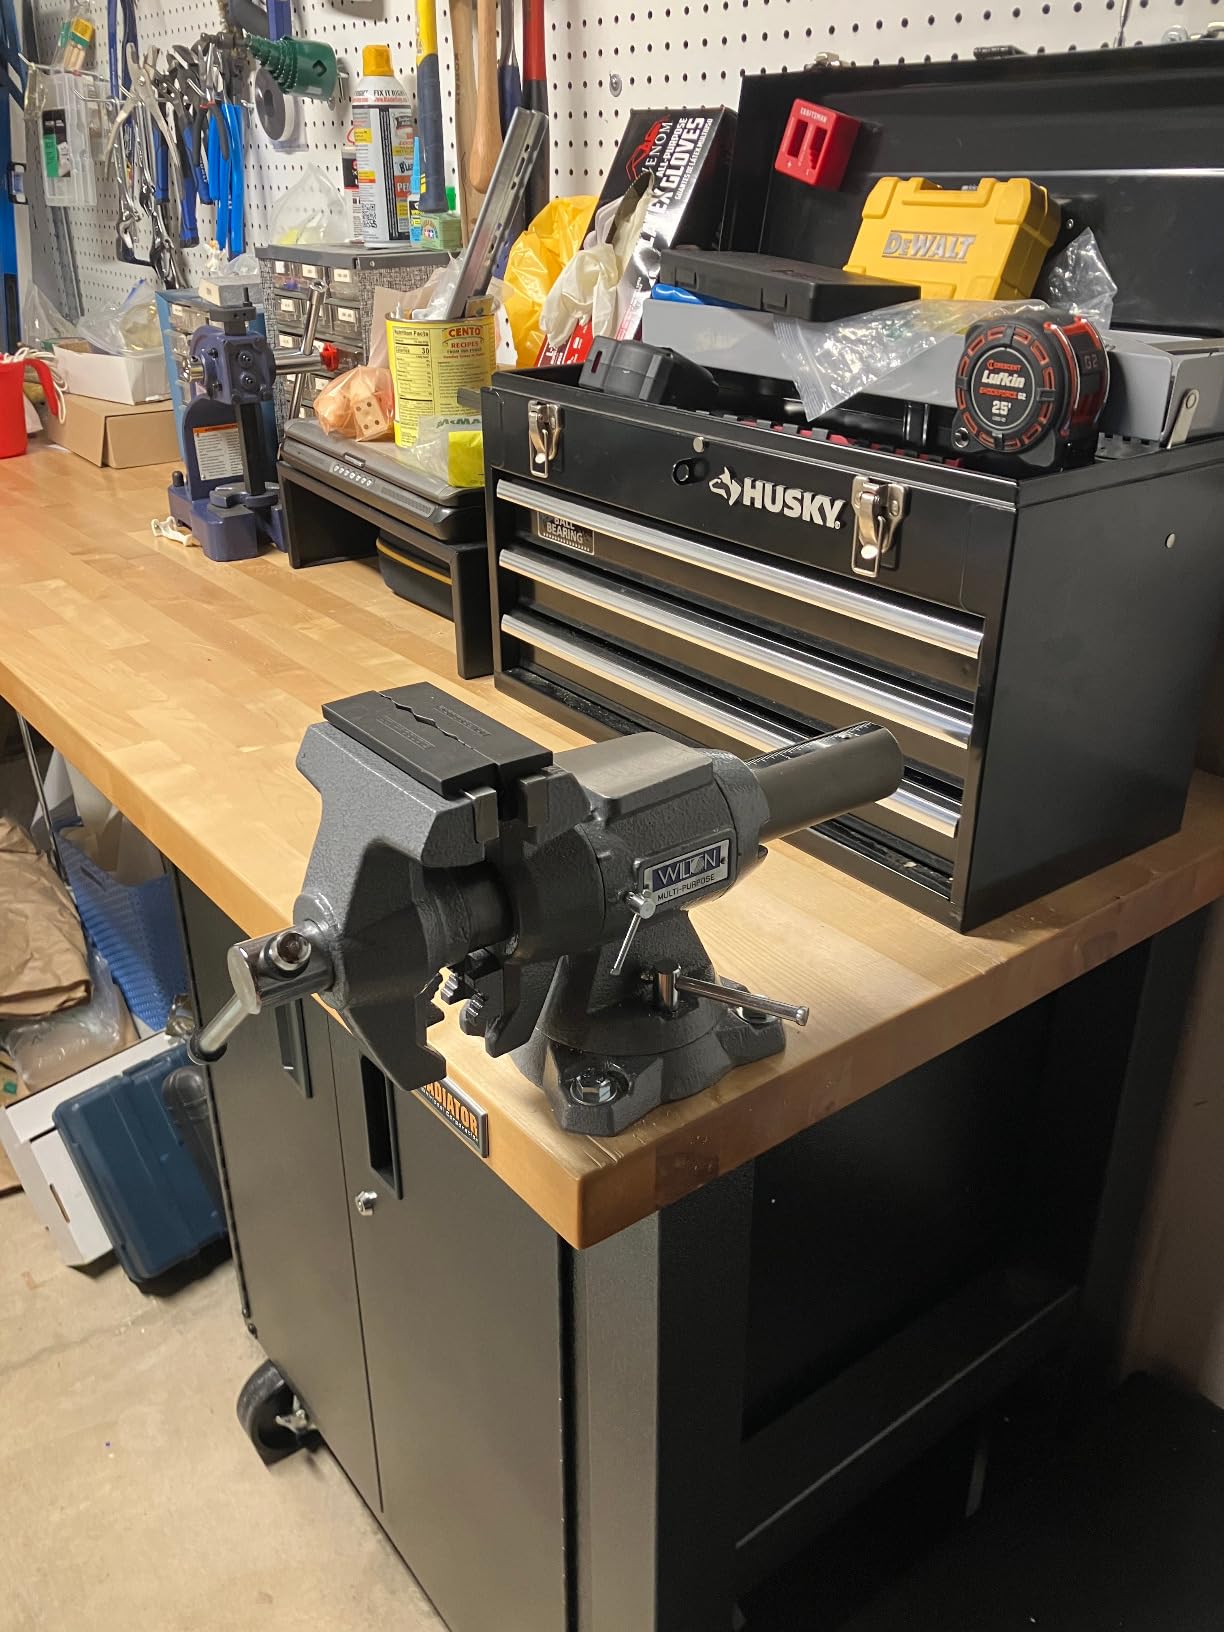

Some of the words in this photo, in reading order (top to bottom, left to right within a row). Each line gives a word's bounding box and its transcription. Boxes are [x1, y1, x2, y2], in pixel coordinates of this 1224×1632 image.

[800, 106, 828, 124] CRAFTSMAN
[656, 117, 688, 177] ALL-PURPOSE
[660, 117, 705, 189] GLOVES
[448, 326, 481, 338] CENTO
[421, 347, 430, 355] 30
[451, 341, 479, 349] RECIPES
[1083, 354, 1098, 370] G2
[981, 369, 1026, 388] Lufkin
[743, 477, 845, 528] HUSKY
[546, 522, 583, 544] BEARING
[554, 517, 576, 530] BALL
[657, 873, 715, 901] MULTI-PURPOSE
[423, 1081, 478, 1137] ADIATOR
